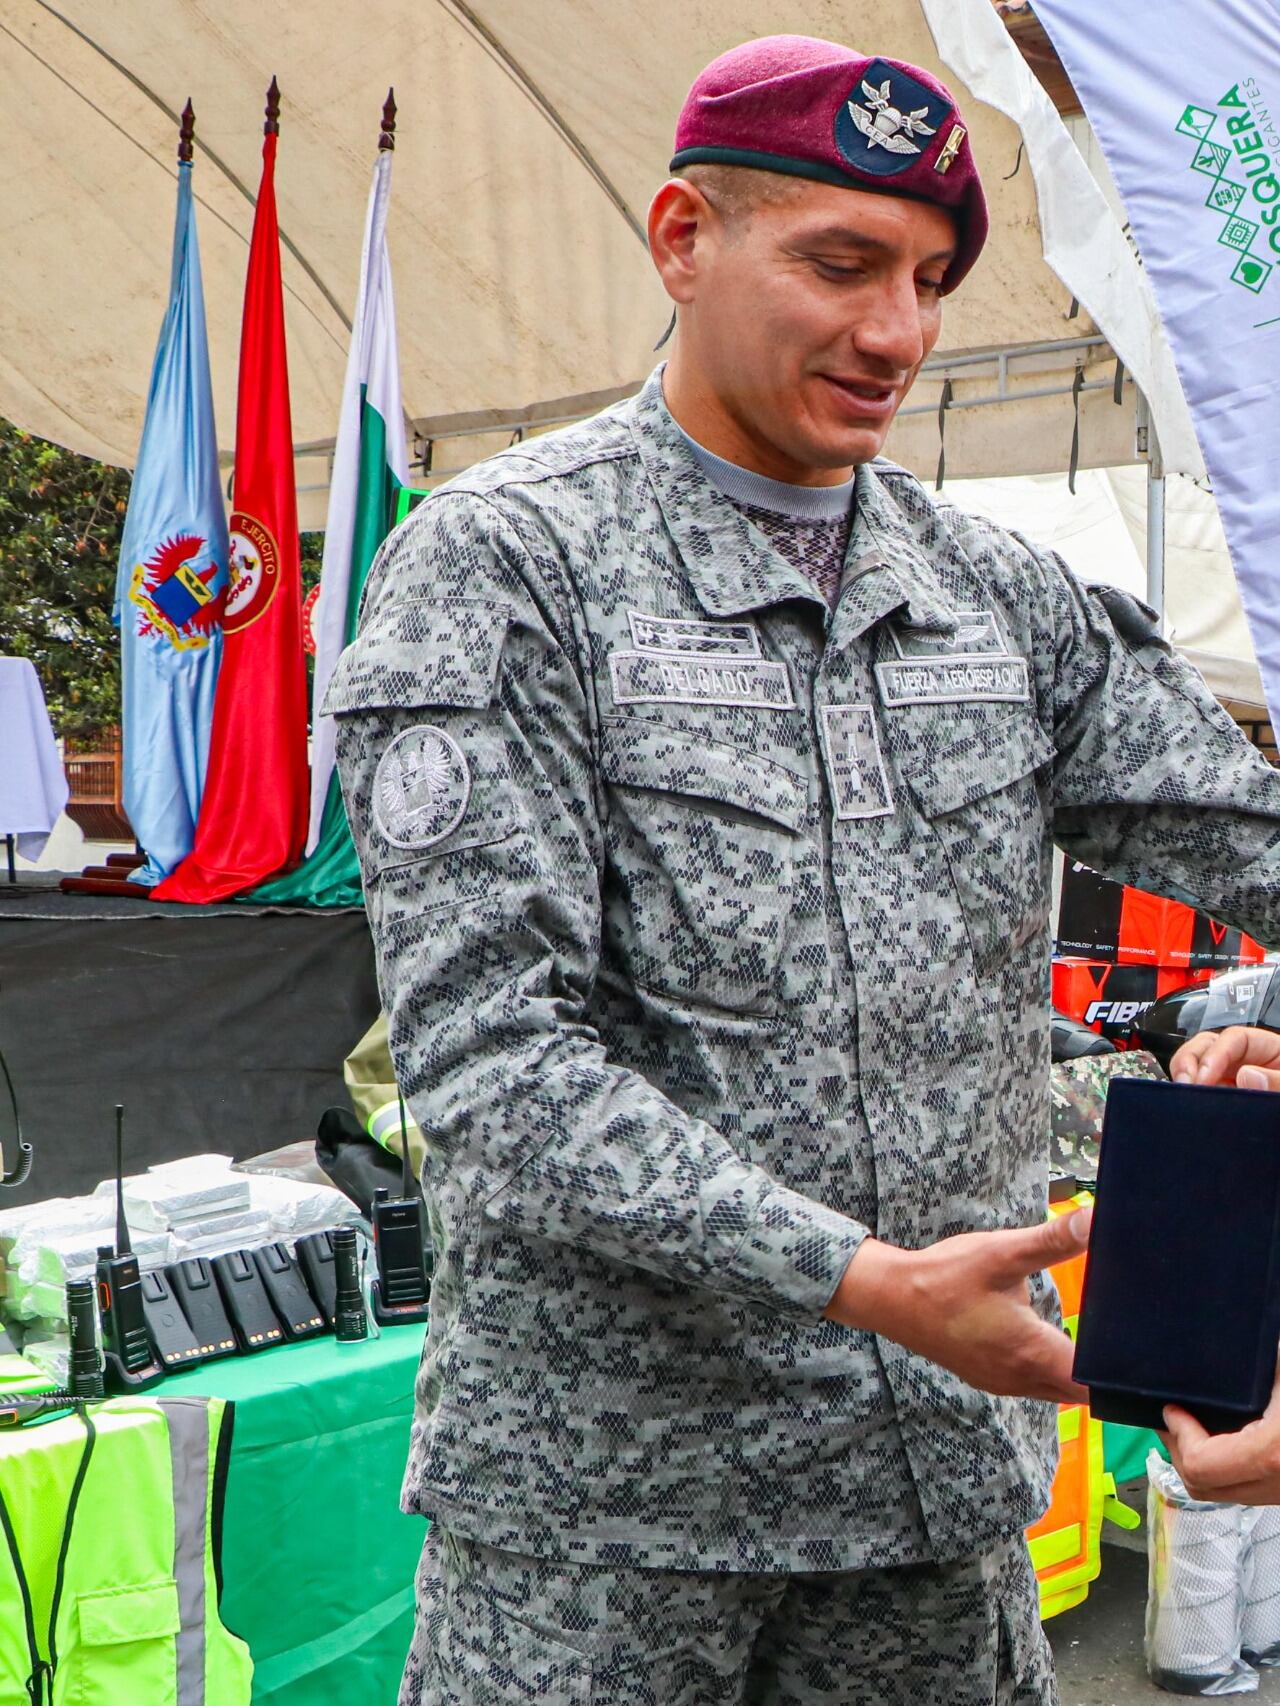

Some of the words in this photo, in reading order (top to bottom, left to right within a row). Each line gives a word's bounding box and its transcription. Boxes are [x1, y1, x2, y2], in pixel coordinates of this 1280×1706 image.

[241, 519, 276, 575] EJERCITO
[660, 665, 750, 695] DELGADO
[890, 671, 939, 692] FUERZA
[943, 667, 1022, 689] AEROESPACIAL
